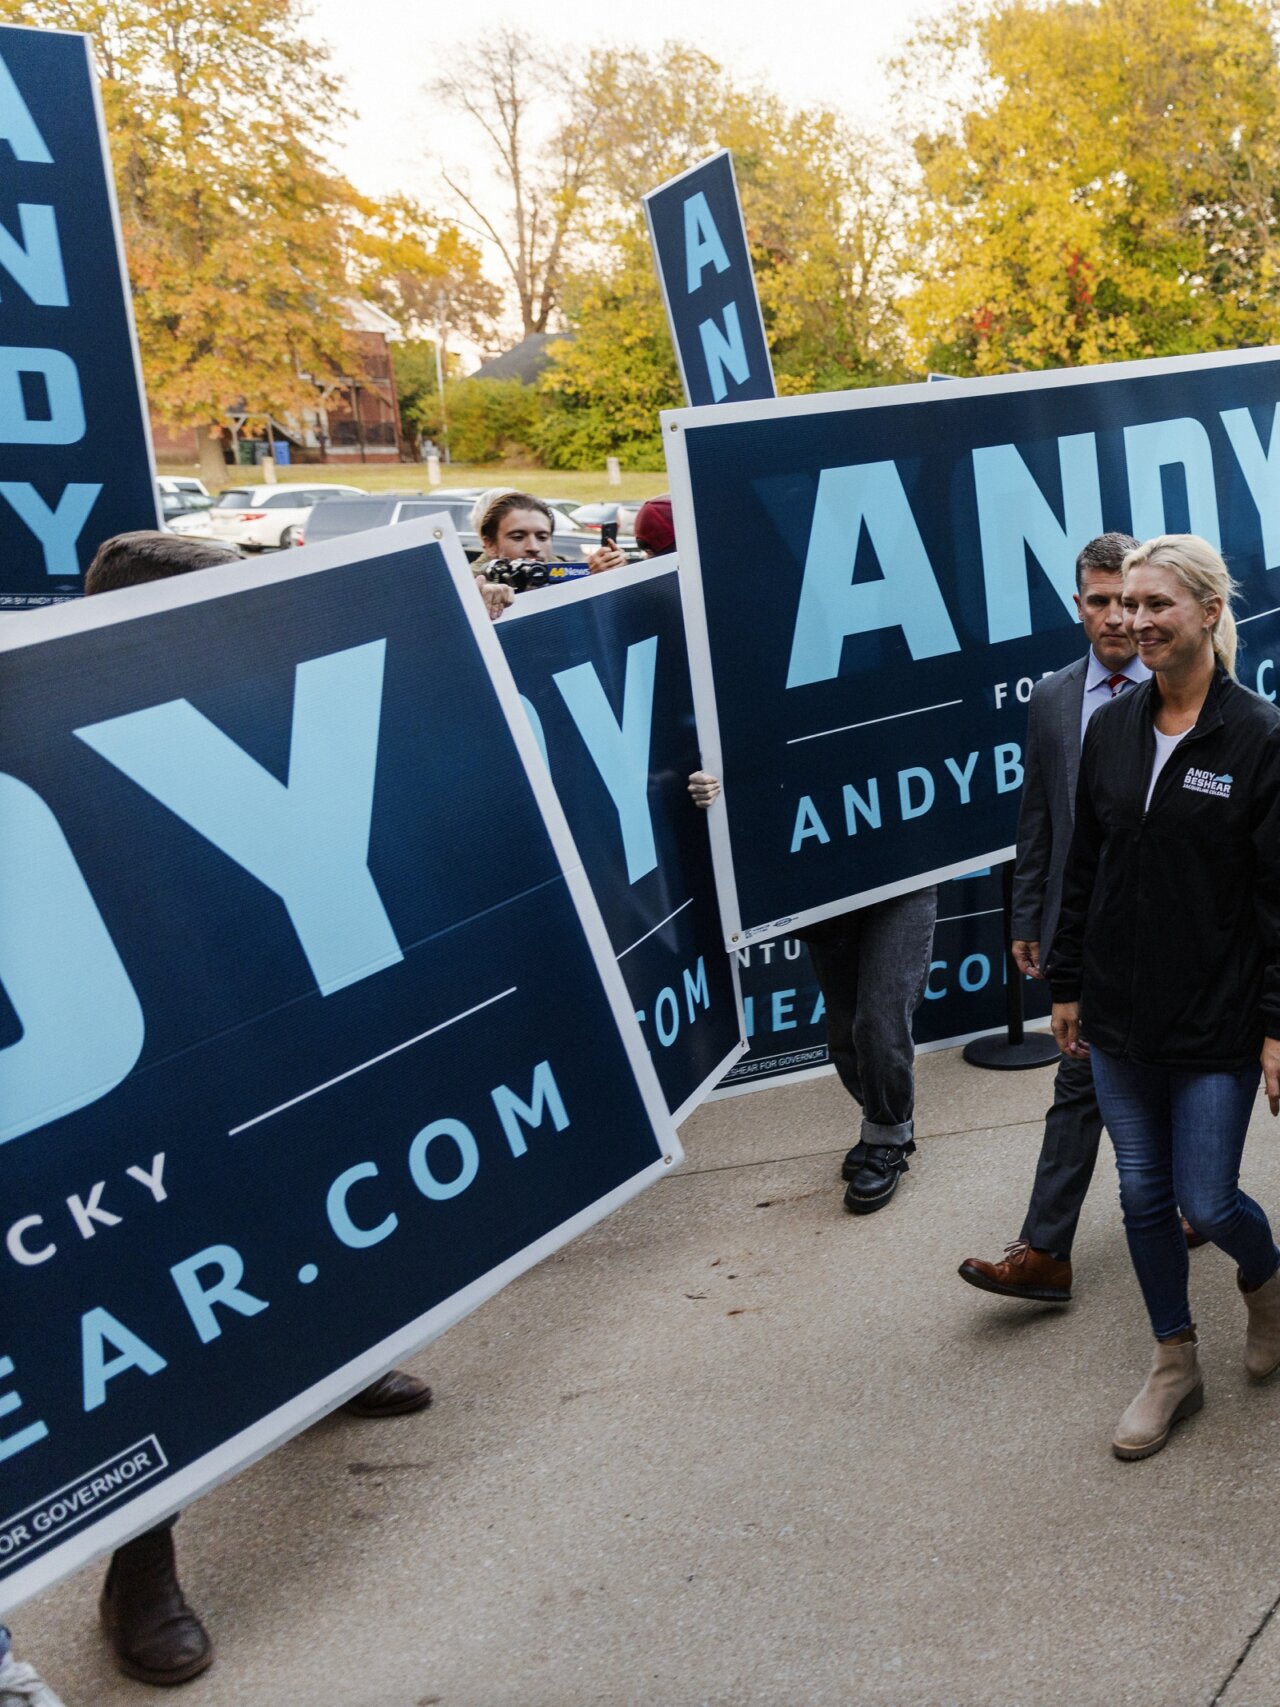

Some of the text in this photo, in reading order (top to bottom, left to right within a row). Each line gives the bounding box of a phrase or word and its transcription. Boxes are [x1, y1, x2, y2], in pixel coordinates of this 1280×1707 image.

[994, 671, 1054, 709] FO
[518, 636, 659, 886] Y
[1184, 775, 1231, 793] BESHEAR
[1187, 767, 1216, 780] ANDY
[790, 742, 1025, 853] ANDYB
[924, 952, 1033, 1000] CO
[759, 1059, 777, 1072] FOR
[777, 1050, 824, 1068] GOVERNOR
[5, 1152, 169, 1266] CKY
[33, 1452, 152, 1532] GOVERNOR
